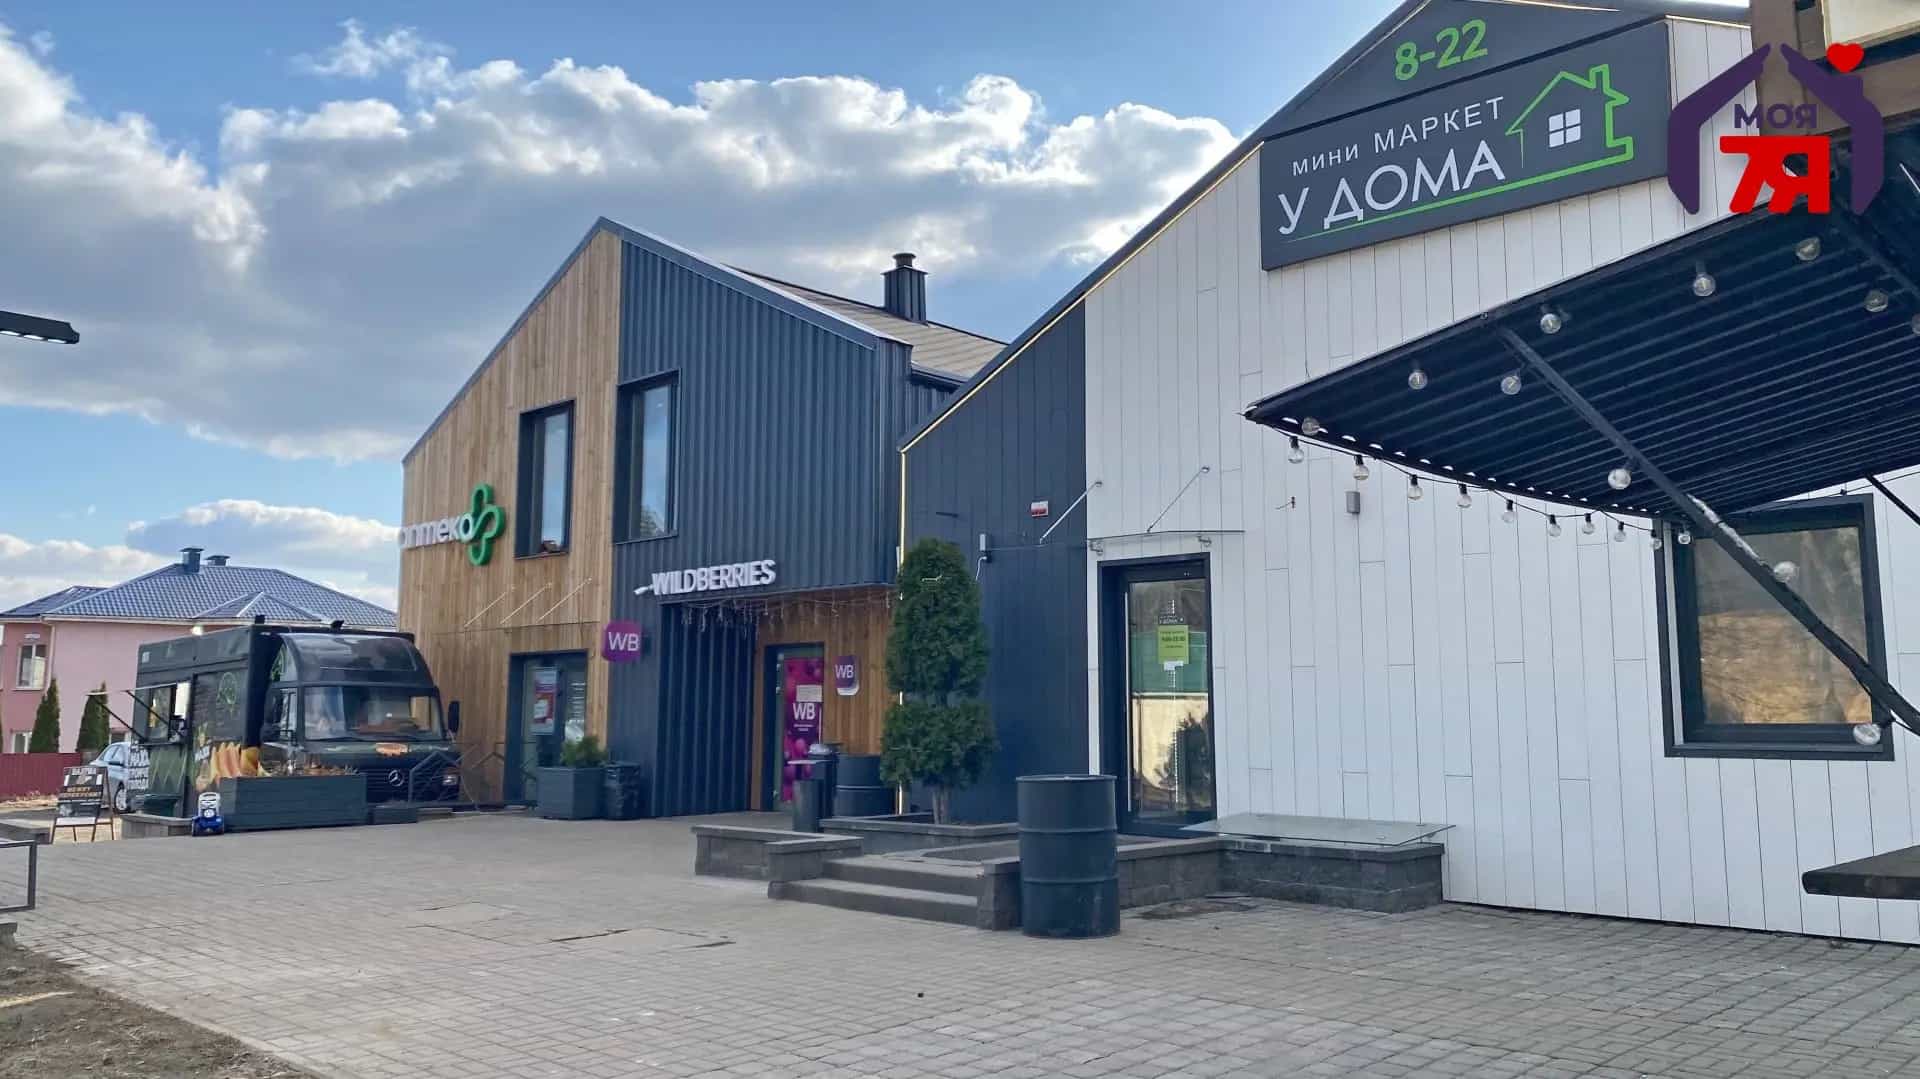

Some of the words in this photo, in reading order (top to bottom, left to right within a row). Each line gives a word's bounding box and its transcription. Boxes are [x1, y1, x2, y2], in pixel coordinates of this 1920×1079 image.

[1394, 19, 1488, 80] 8-22
[1374, 96, 1504, 153] МАРКЕТ
[1278, 187, 1309, 235] У
[1323, 140, 1505, 229] ДОМА
[652, 560, 776, 595] WILDBERRIES
[608, 632, 639, 651] WB
[834, 664, 854, 679] WB
[792, 702, 816, 720] WB
